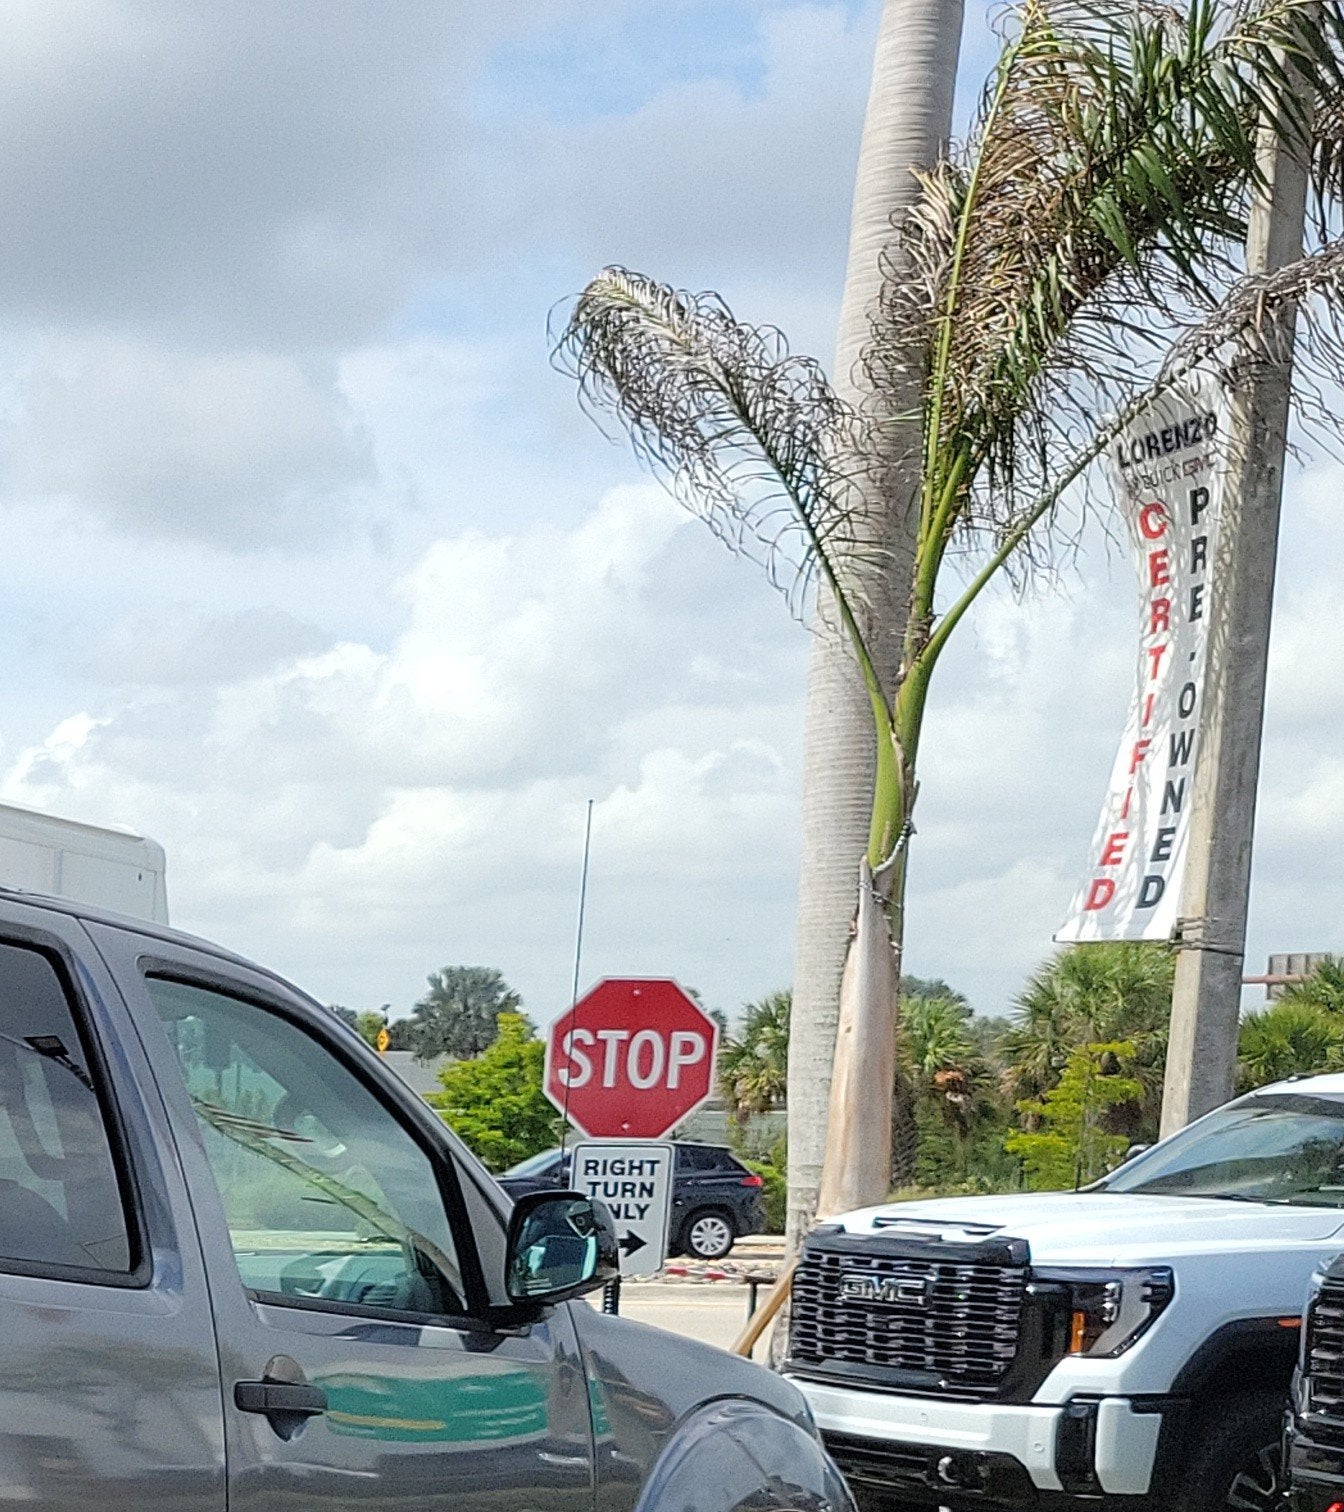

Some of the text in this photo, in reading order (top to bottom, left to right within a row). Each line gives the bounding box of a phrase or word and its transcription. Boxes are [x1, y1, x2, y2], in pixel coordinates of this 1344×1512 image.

[1117, 412, 1218, 469] LORENZO
[1083, 502, 1170, 912] CERTIFIED
[558, 1027, 706, 1090] STOP
[583, 1158, 661, 1177] RIGHT
[586, 1181, 655, 1198] TURN
[607, 1203, 651, 1221] NLY
[839, 1273, 926, 1305] GMC
